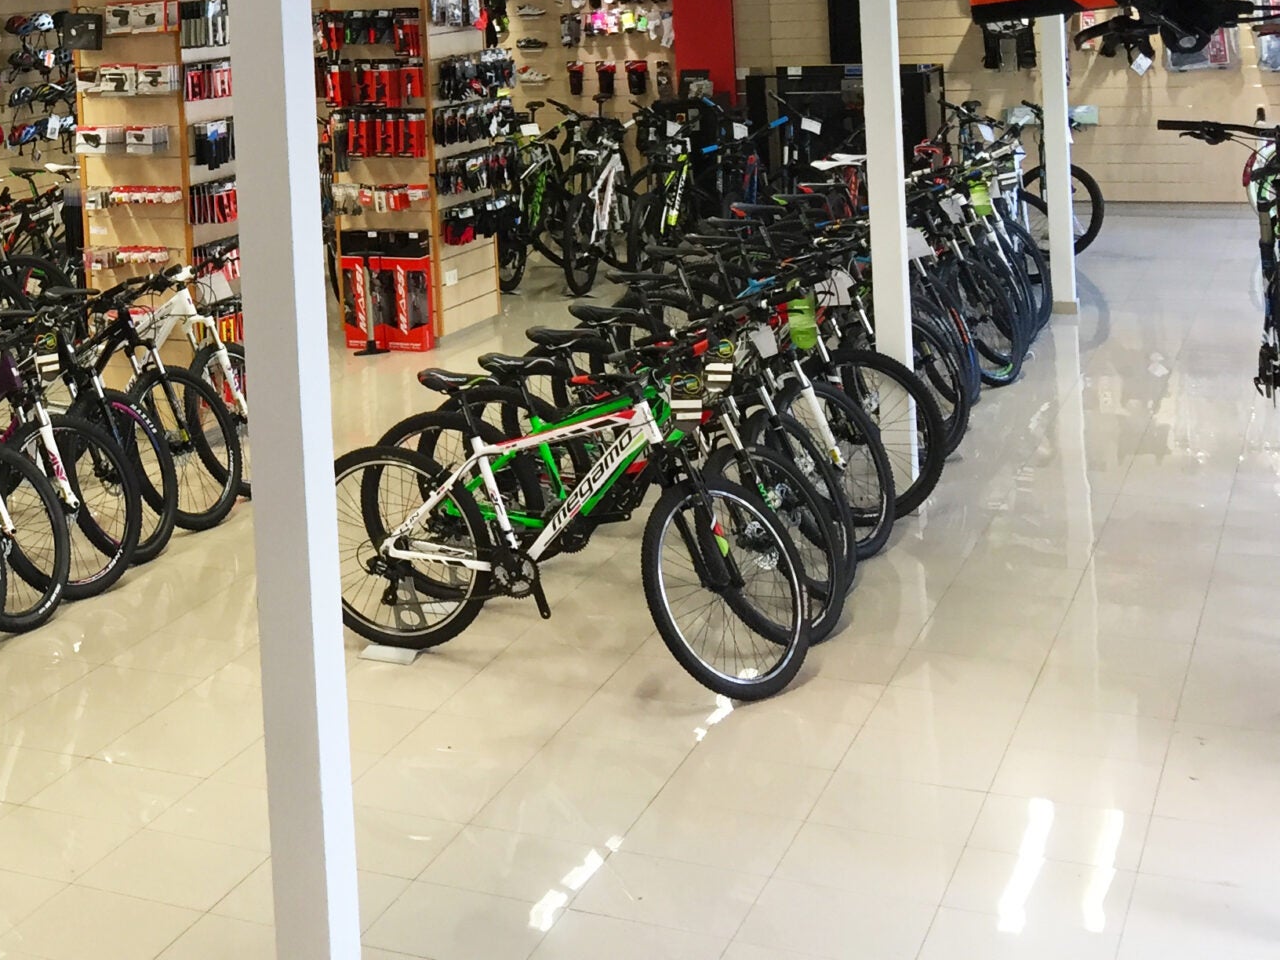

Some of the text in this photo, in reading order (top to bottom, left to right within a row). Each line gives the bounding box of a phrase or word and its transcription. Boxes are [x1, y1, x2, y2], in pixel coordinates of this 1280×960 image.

[355, 263, 368, 335] MASSI
[396, 264, 408, 336] MASSI
[129, 403, 158, 434] MAXXIS
[551, 429, 633, 532] megamo
